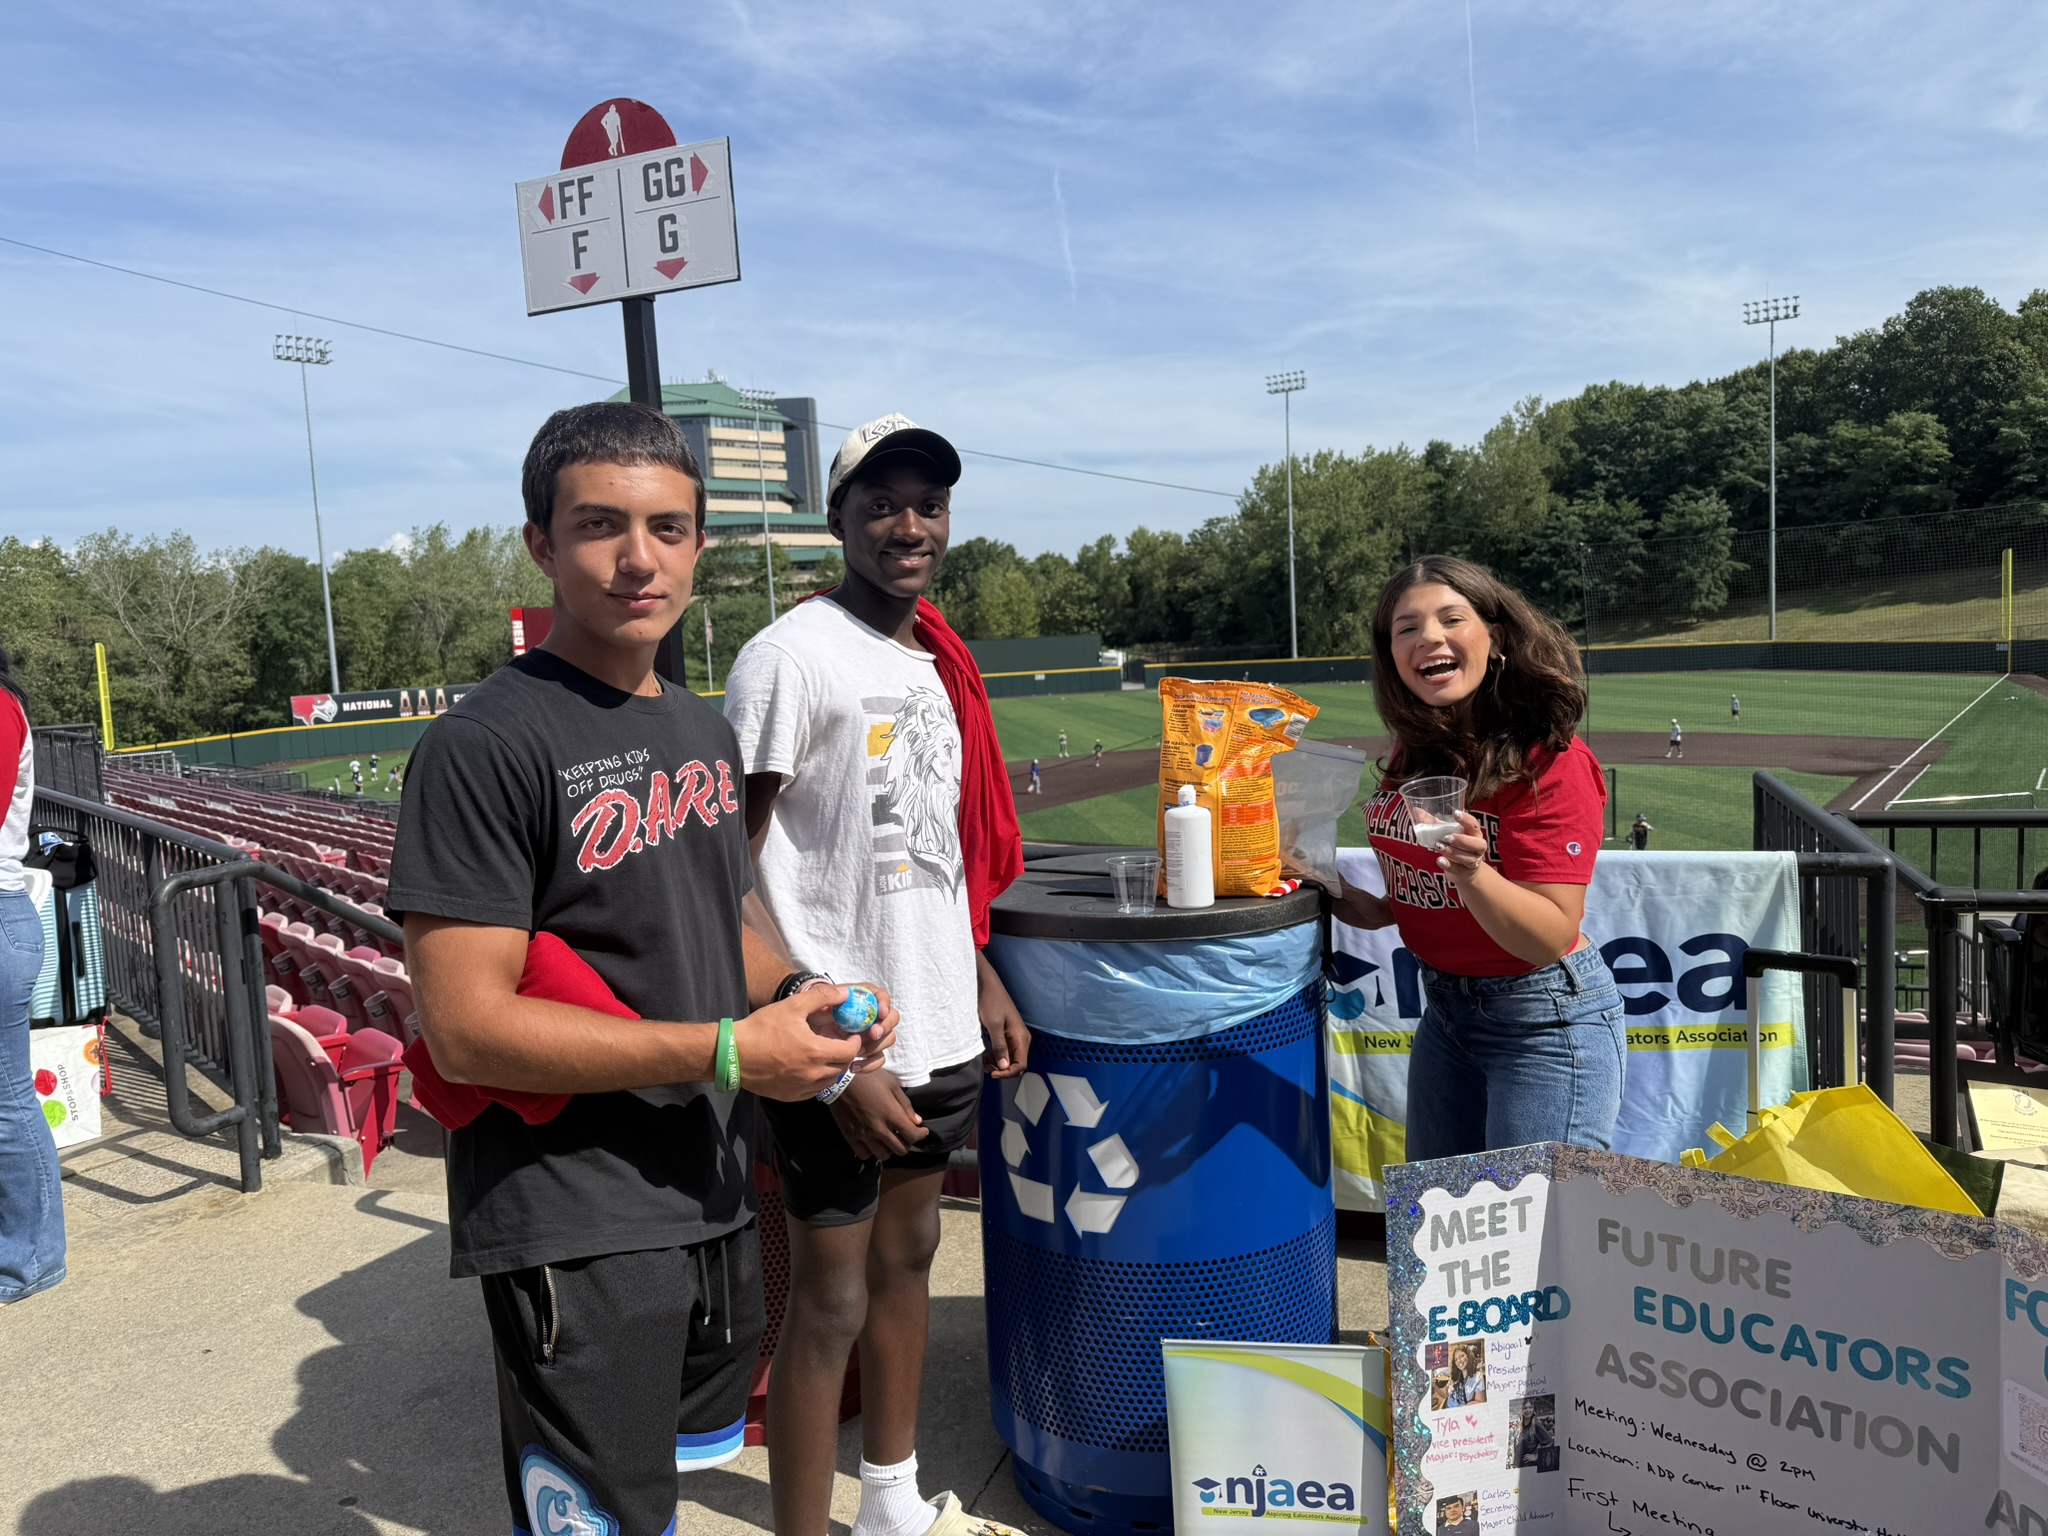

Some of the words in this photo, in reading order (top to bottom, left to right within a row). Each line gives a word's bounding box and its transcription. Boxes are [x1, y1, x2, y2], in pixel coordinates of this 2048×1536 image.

[642, 157, 686, 203] GG
[558, 175, 594, 220] FF
[658, 213, 679, 254] G
[572, 229, 589, 270] F
[342, 699, 393, 712] NATIONAL
[624, 748, 650, 765] KIDS
[566, 781, 594, 798] OFF
[1364, 1035, 1401, 1048] New
[1676, 1028, 1778, 1044] Associaton
[1430, 1195, 1533, 1252] MEET
[1597, 1217, 1792, 1300] FUTURE
[1438, 1250, 1511, 1298] THE
[1428, 1285, 1571, 1342] E-BOARD
[1491, 1338, 1522, 1360] Abigail
[1633, 1285, 1972, 1400] EDUCATORS
[1487, 1361, 1536, 1377] President
[1487, 1380, 1516, 1392] Major:
[1594, 1343, 1961, 1474] ASSOCIATION
[1432, 1416, 1460, 1437] Tyla
[1650, 1421, 1737, 1465] Wednesday
[1746, 1453, 1767, 1472] @
[1568, 1437, 1640, 1470] Location:
[1647, 1462, 1675, 1482] ADP
[1682, 1473, 1724, 1493] Center
[1759, 1490, 1800, 1511] Floor
[1226, 1464, 1355, 1518] njaea
[1482, 1488, 1511, 1500] Carlos
[1567, 1477, 1619, 1507] First
[1229, 1509, 1249, 1517] Jersey
[1266, 1510, 1292, 1519] Aspiring
[1293, 1512, 1324, 1520] Educators
[1325, 1515, 1361, 1523] Association
[1480, 1503, 1519, 1516] Secretary
[1480, 1518, 1506, 1531] Major:
[1506, 1511, 1527, 1525] Child
